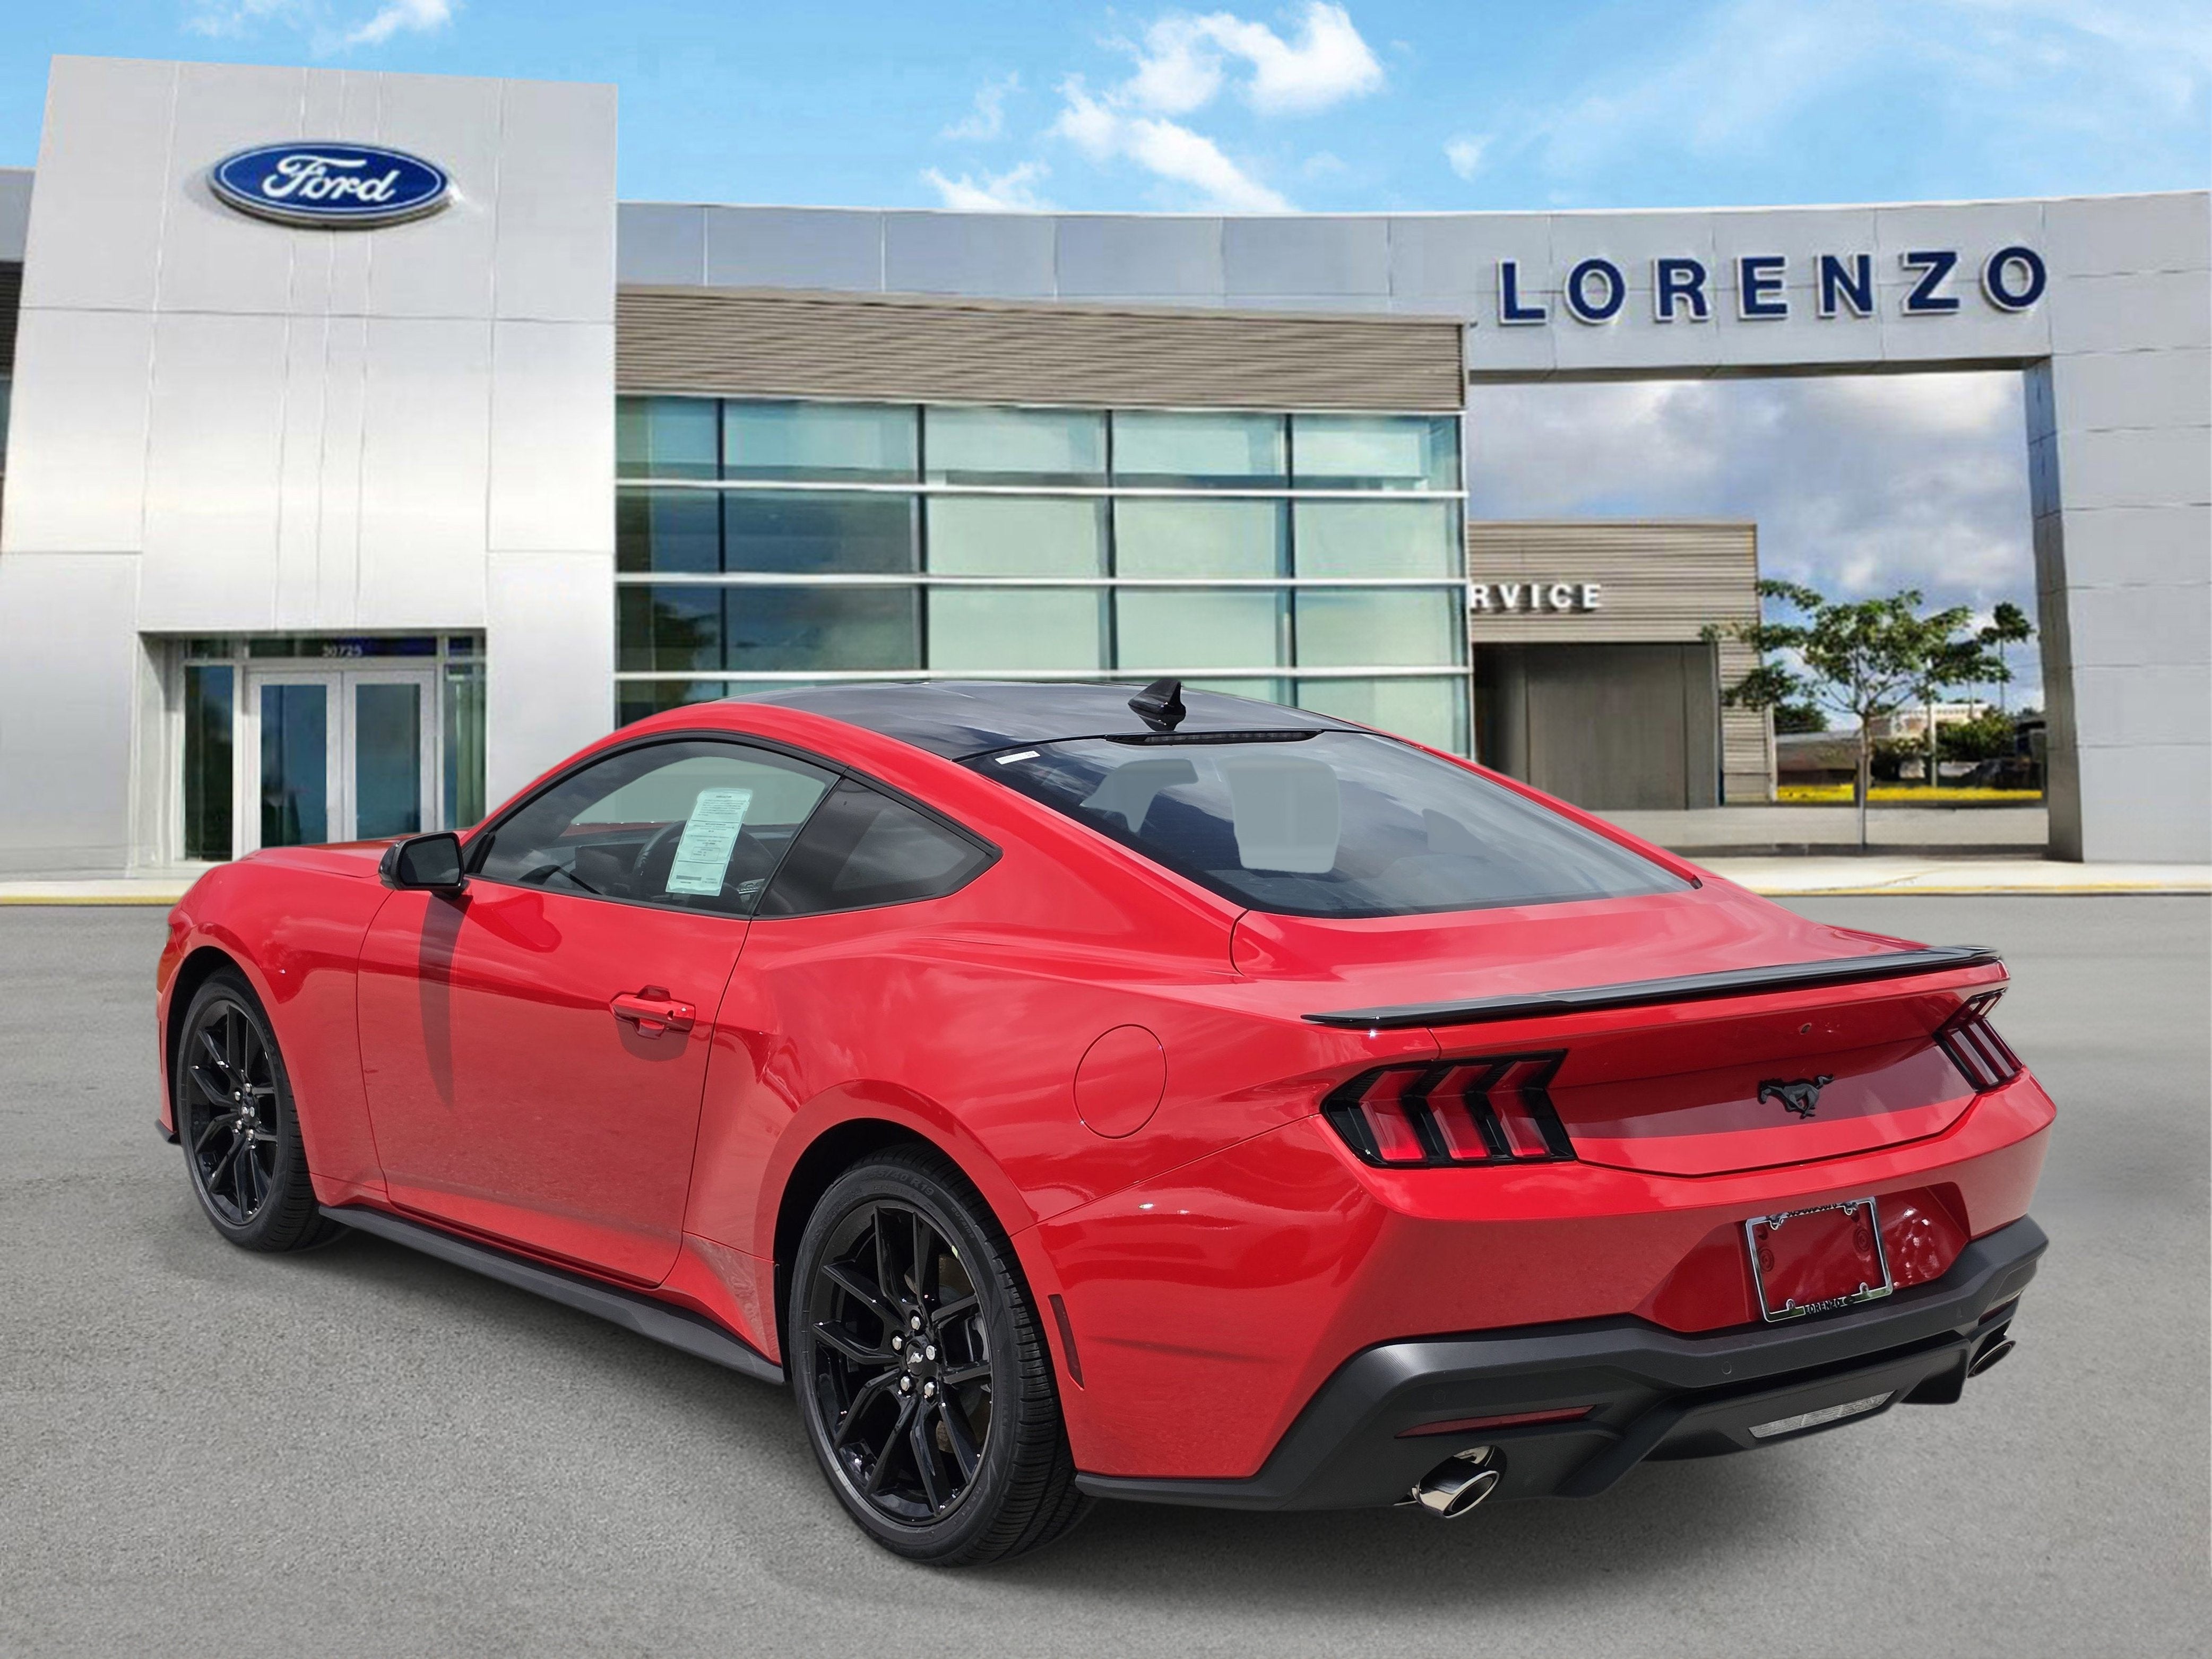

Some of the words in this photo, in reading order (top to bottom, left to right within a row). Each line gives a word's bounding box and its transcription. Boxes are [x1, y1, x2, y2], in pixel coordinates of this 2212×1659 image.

[262, 154, 401, 202] Ford
[1496, 245, 2048, 324] LORENZO
[1468, 583, 1602, 609] RVICE
[910, 1177, 935, 1196] R19
[951, 1207, 975, 1239] OUTSIDE
[1804, 1298, 1842, 1315] LORENZO
